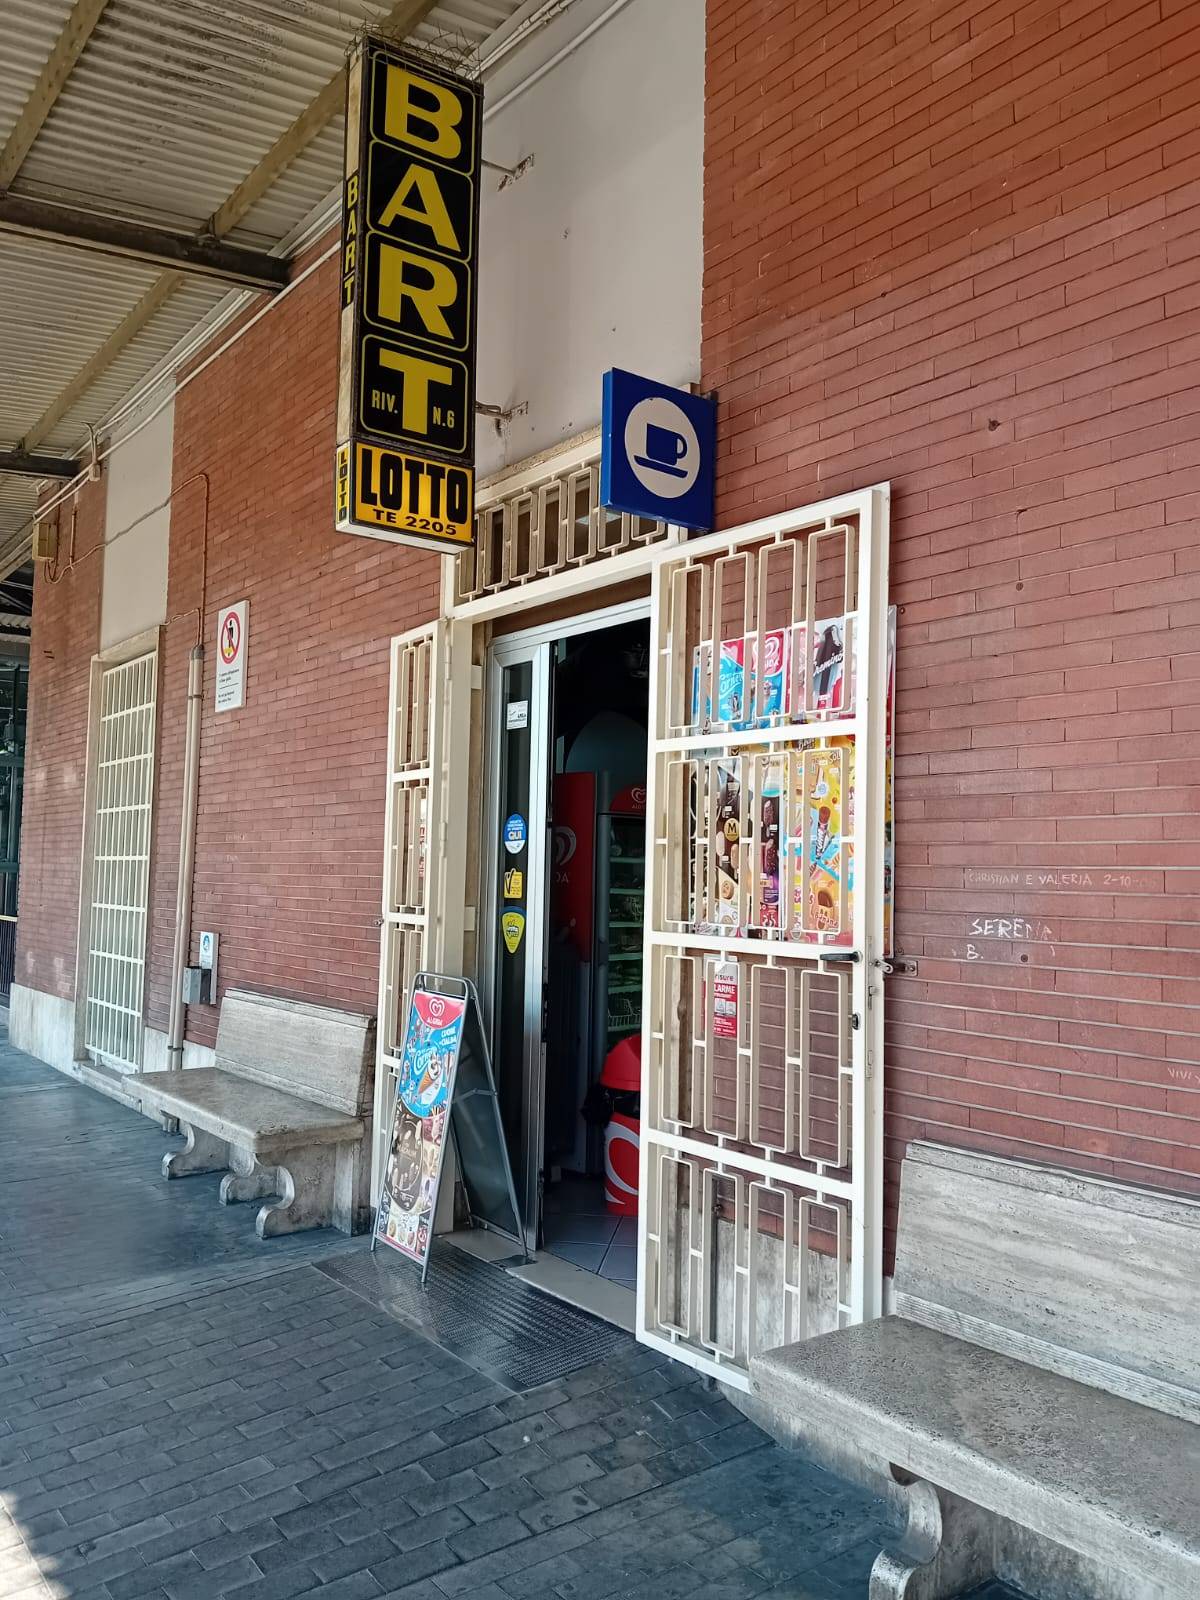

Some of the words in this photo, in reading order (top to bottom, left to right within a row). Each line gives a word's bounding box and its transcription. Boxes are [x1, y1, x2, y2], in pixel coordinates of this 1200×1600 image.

[371, 389, 399, 414] RIV.
[432, 406, 455, 429] N.6
[361, 448, 468, 525] LOTTO
[373, 508, 397, 524] TE
[405, 515, 457, 536] 2205
[1025, 874, 1034, 885] E
[1038, 874, 1093, 887] VALERIA
